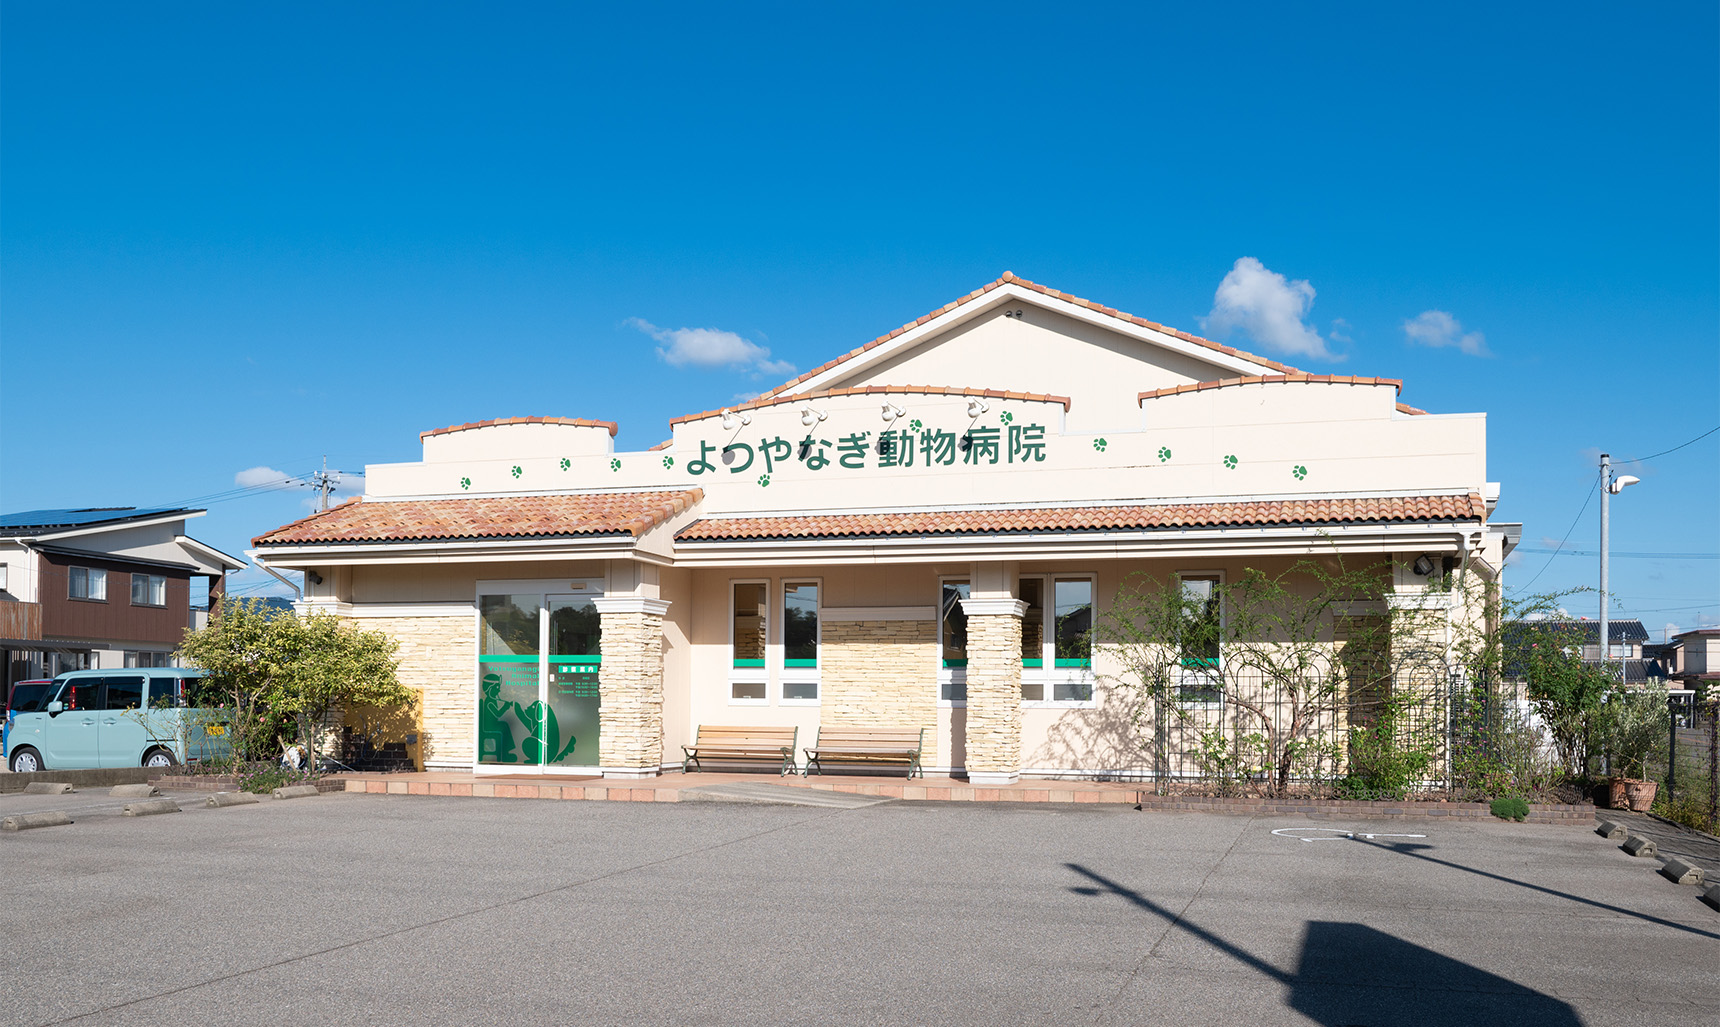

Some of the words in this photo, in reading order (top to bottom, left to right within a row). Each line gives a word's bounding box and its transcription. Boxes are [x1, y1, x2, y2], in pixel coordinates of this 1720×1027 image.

[686, 423, 1046, 475] よつやなぎ動物病院
